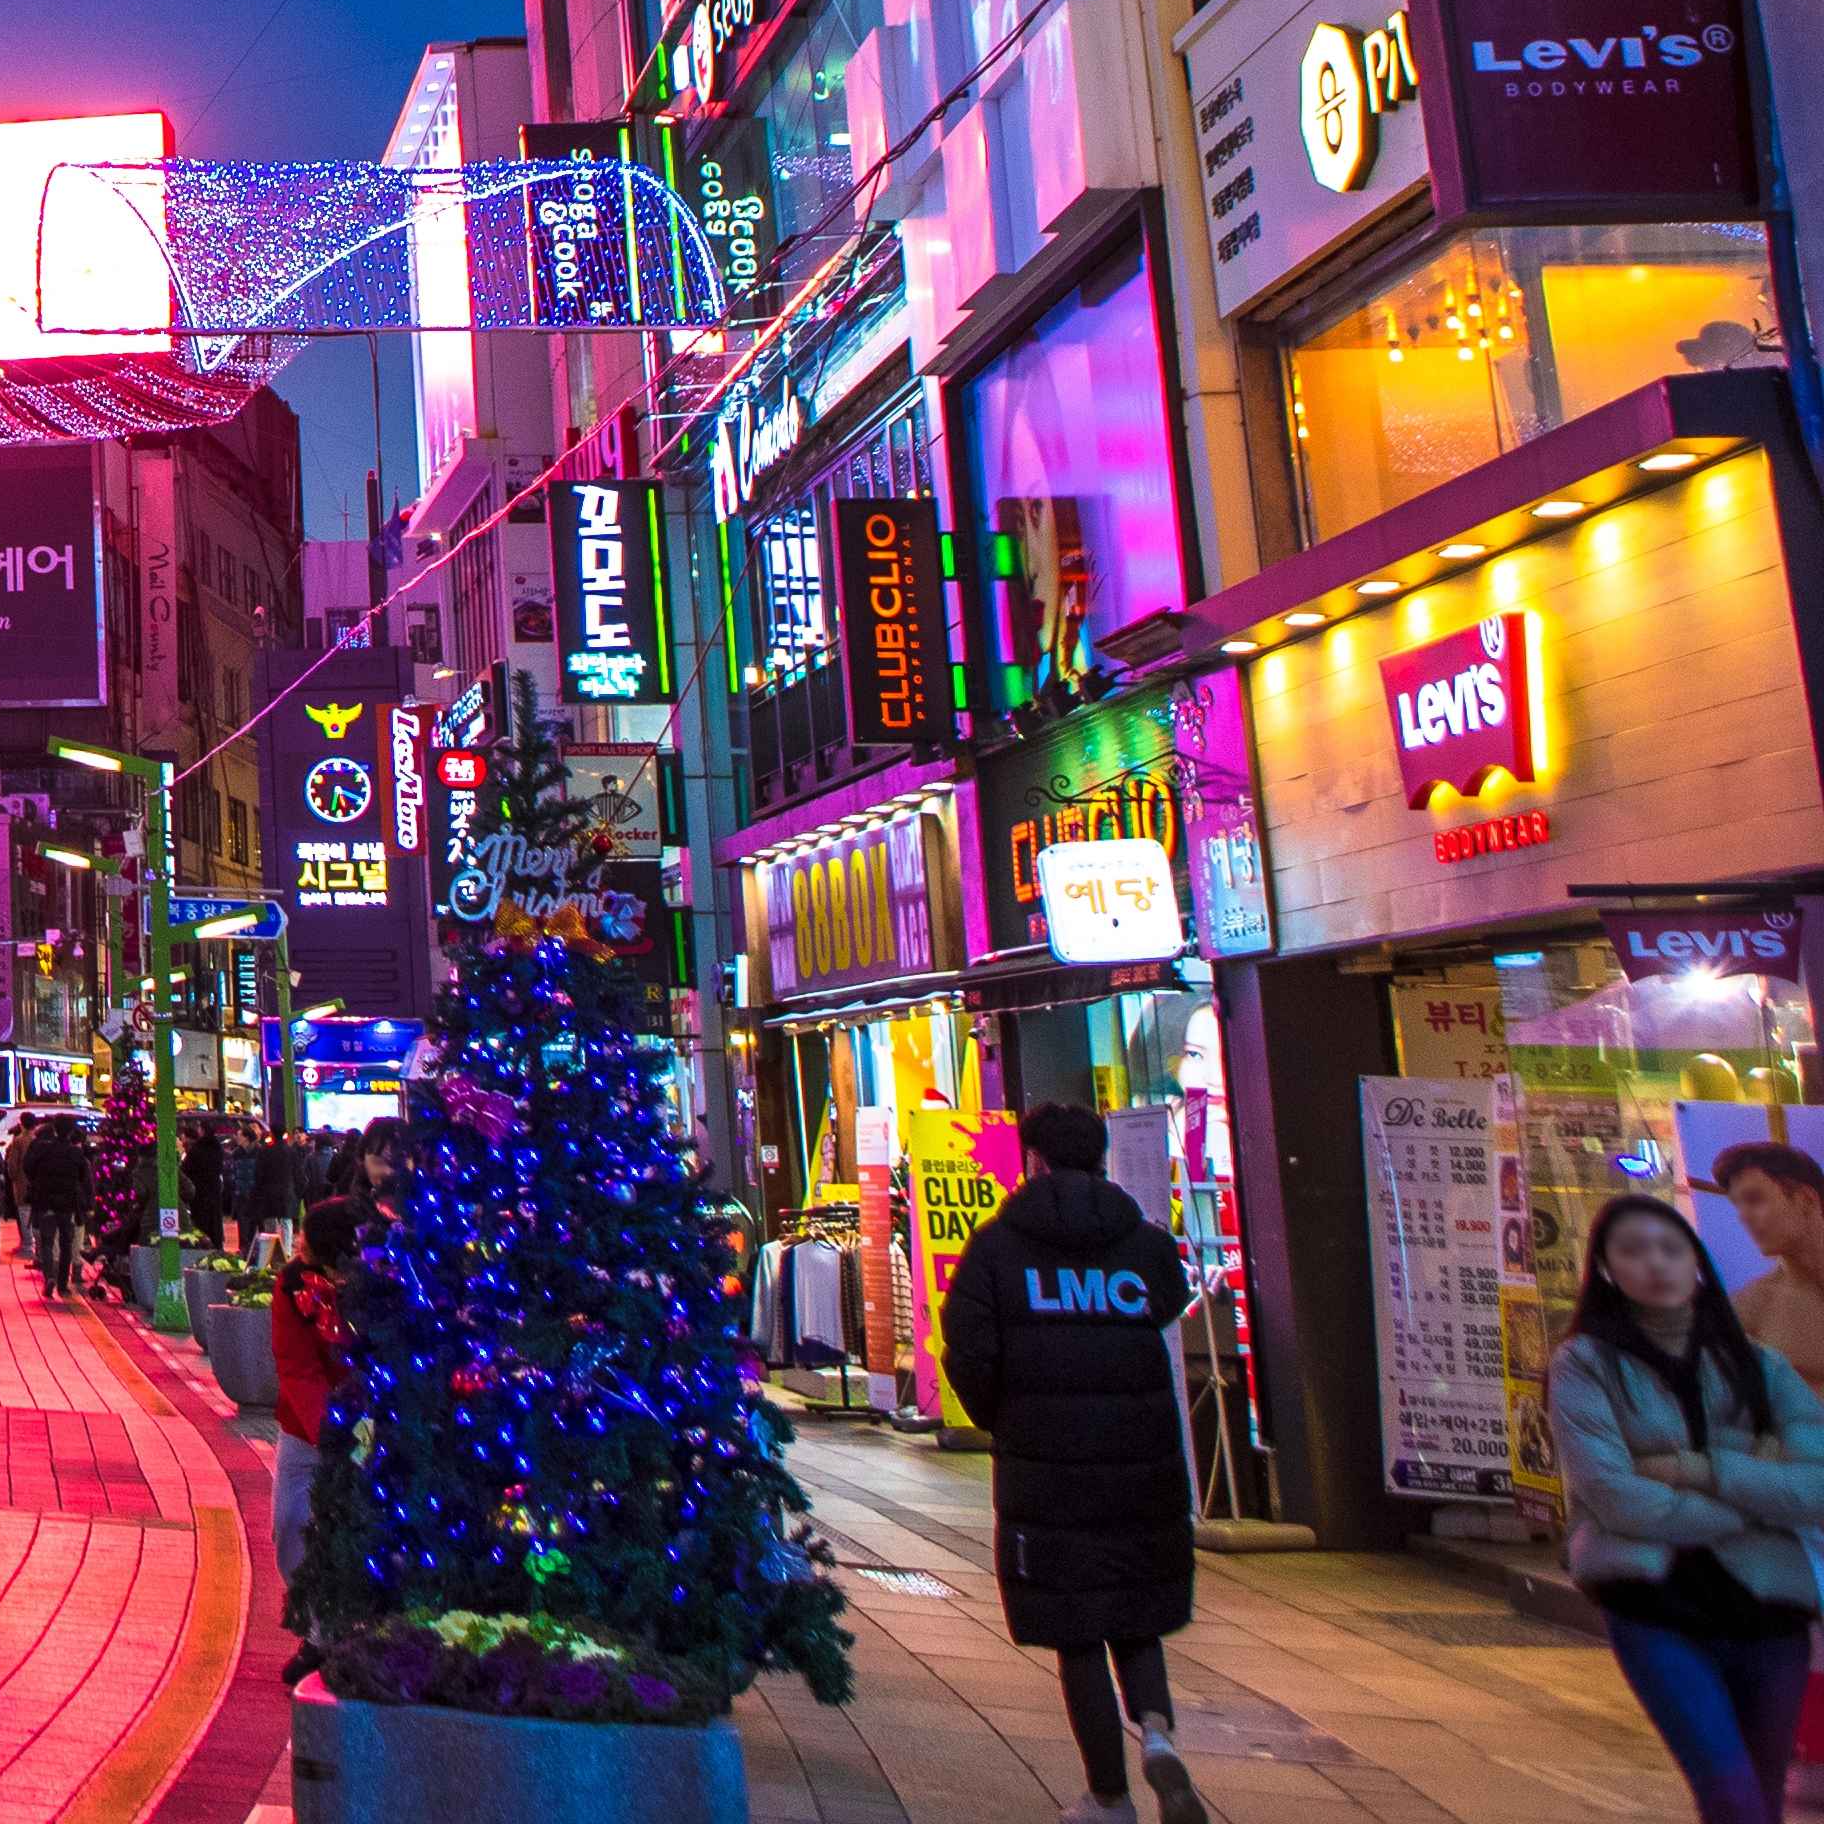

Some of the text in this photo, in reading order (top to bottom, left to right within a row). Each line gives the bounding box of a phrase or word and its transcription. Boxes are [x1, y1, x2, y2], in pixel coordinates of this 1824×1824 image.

[1505, 79, 1681, 98] BODYWEAR
[612, 828, 658, 841] ocker
[1435, 810, 1549, 862] BODYWEAR
[297, 861, 388, 890] 시그널
[793, 843, 896, 978] 88BOX
[1425, 1001, 1487, 1034] 뷰티
[1383, 1097, 1487, 1130] De Belle
[925, 1176, 995, 1208] CLUB
[928, 1209, 979, 1241] DAY
[1025, 1268, 1148, 1314] LMC
[1452, 1438, 1508, 1456] 20.000
